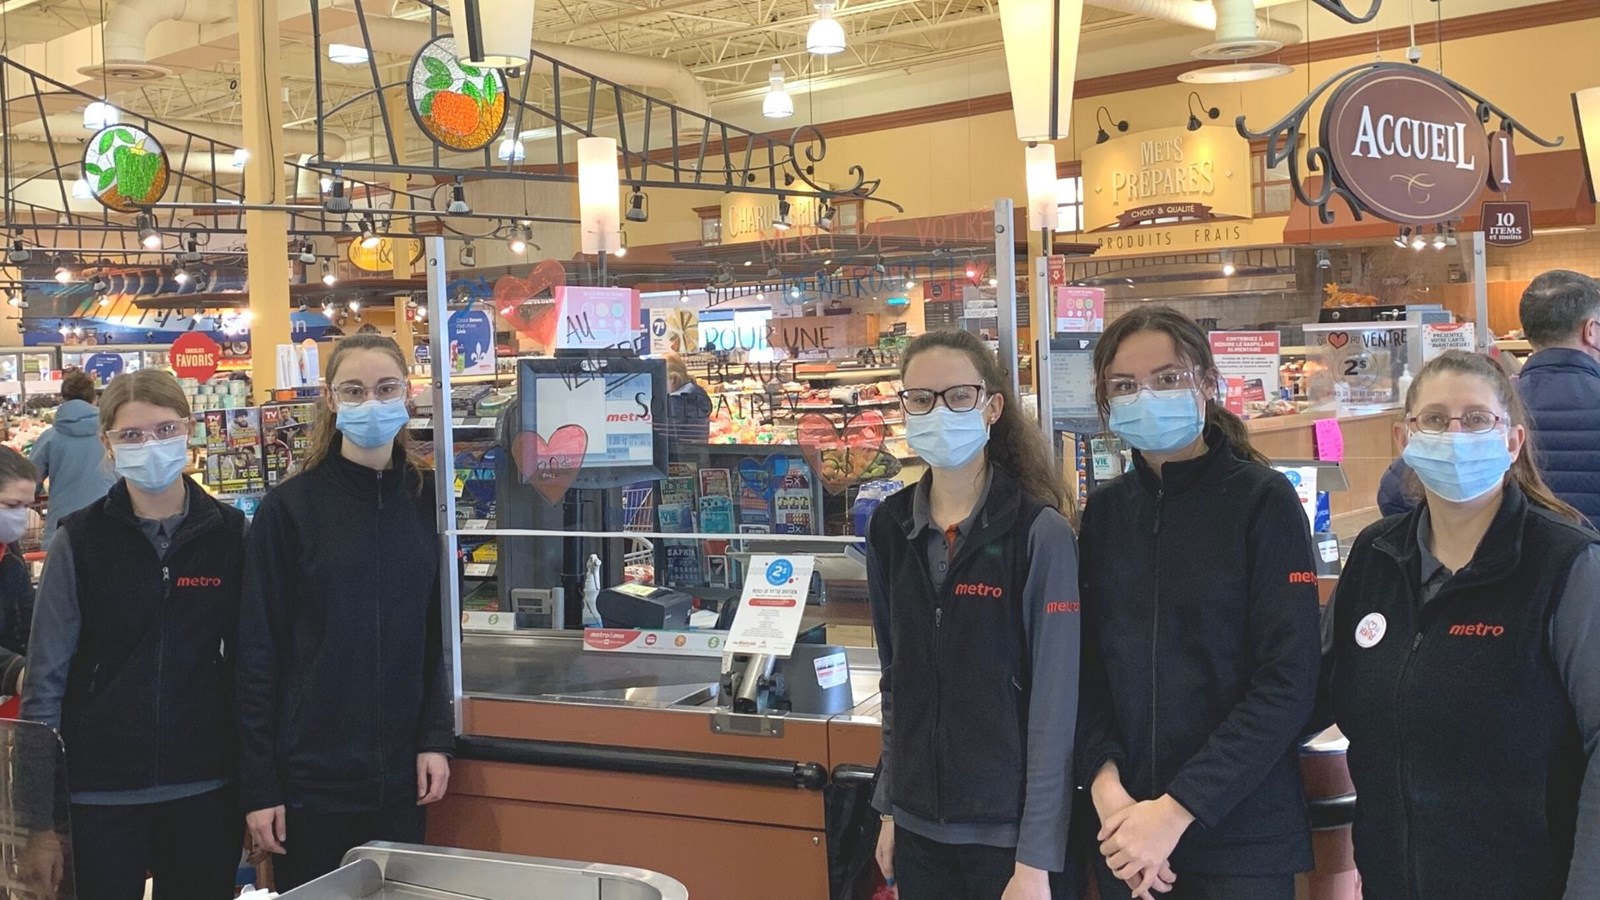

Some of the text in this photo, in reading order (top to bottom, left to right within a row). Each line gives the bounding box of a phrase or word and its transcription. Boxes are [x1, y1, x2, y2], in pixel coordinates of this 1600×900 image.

[1351, 105, 1474, 170] ACCUEIL
[1140, 137, 1183, 166] METS
[1112, 160, 1215, 206] PRÉPARÉS
[1130, 210, 1155, 219] CHOIX
[1166, 204, 1195, 214] QUALITÉ
[1496, 212, 1515, 226] 10
[1194, 226, 1240, 242] FRAIS
[1490, 226, 1522, 234] ITEMS
[567, 311, 595, 344] AU
[705, 326, 834, 351] POUR UNE
[1362, 329, 1407, 348] VENTRE
[175, 353, 215, 367] FAVORIS
[265, 411, 277, 419] TV
[606, 412, 651, 422] metro
[177, 576, 221, 587] metro
[955, 583, 1002, 597] metro
[1449, 622, 1504, 637] metro
